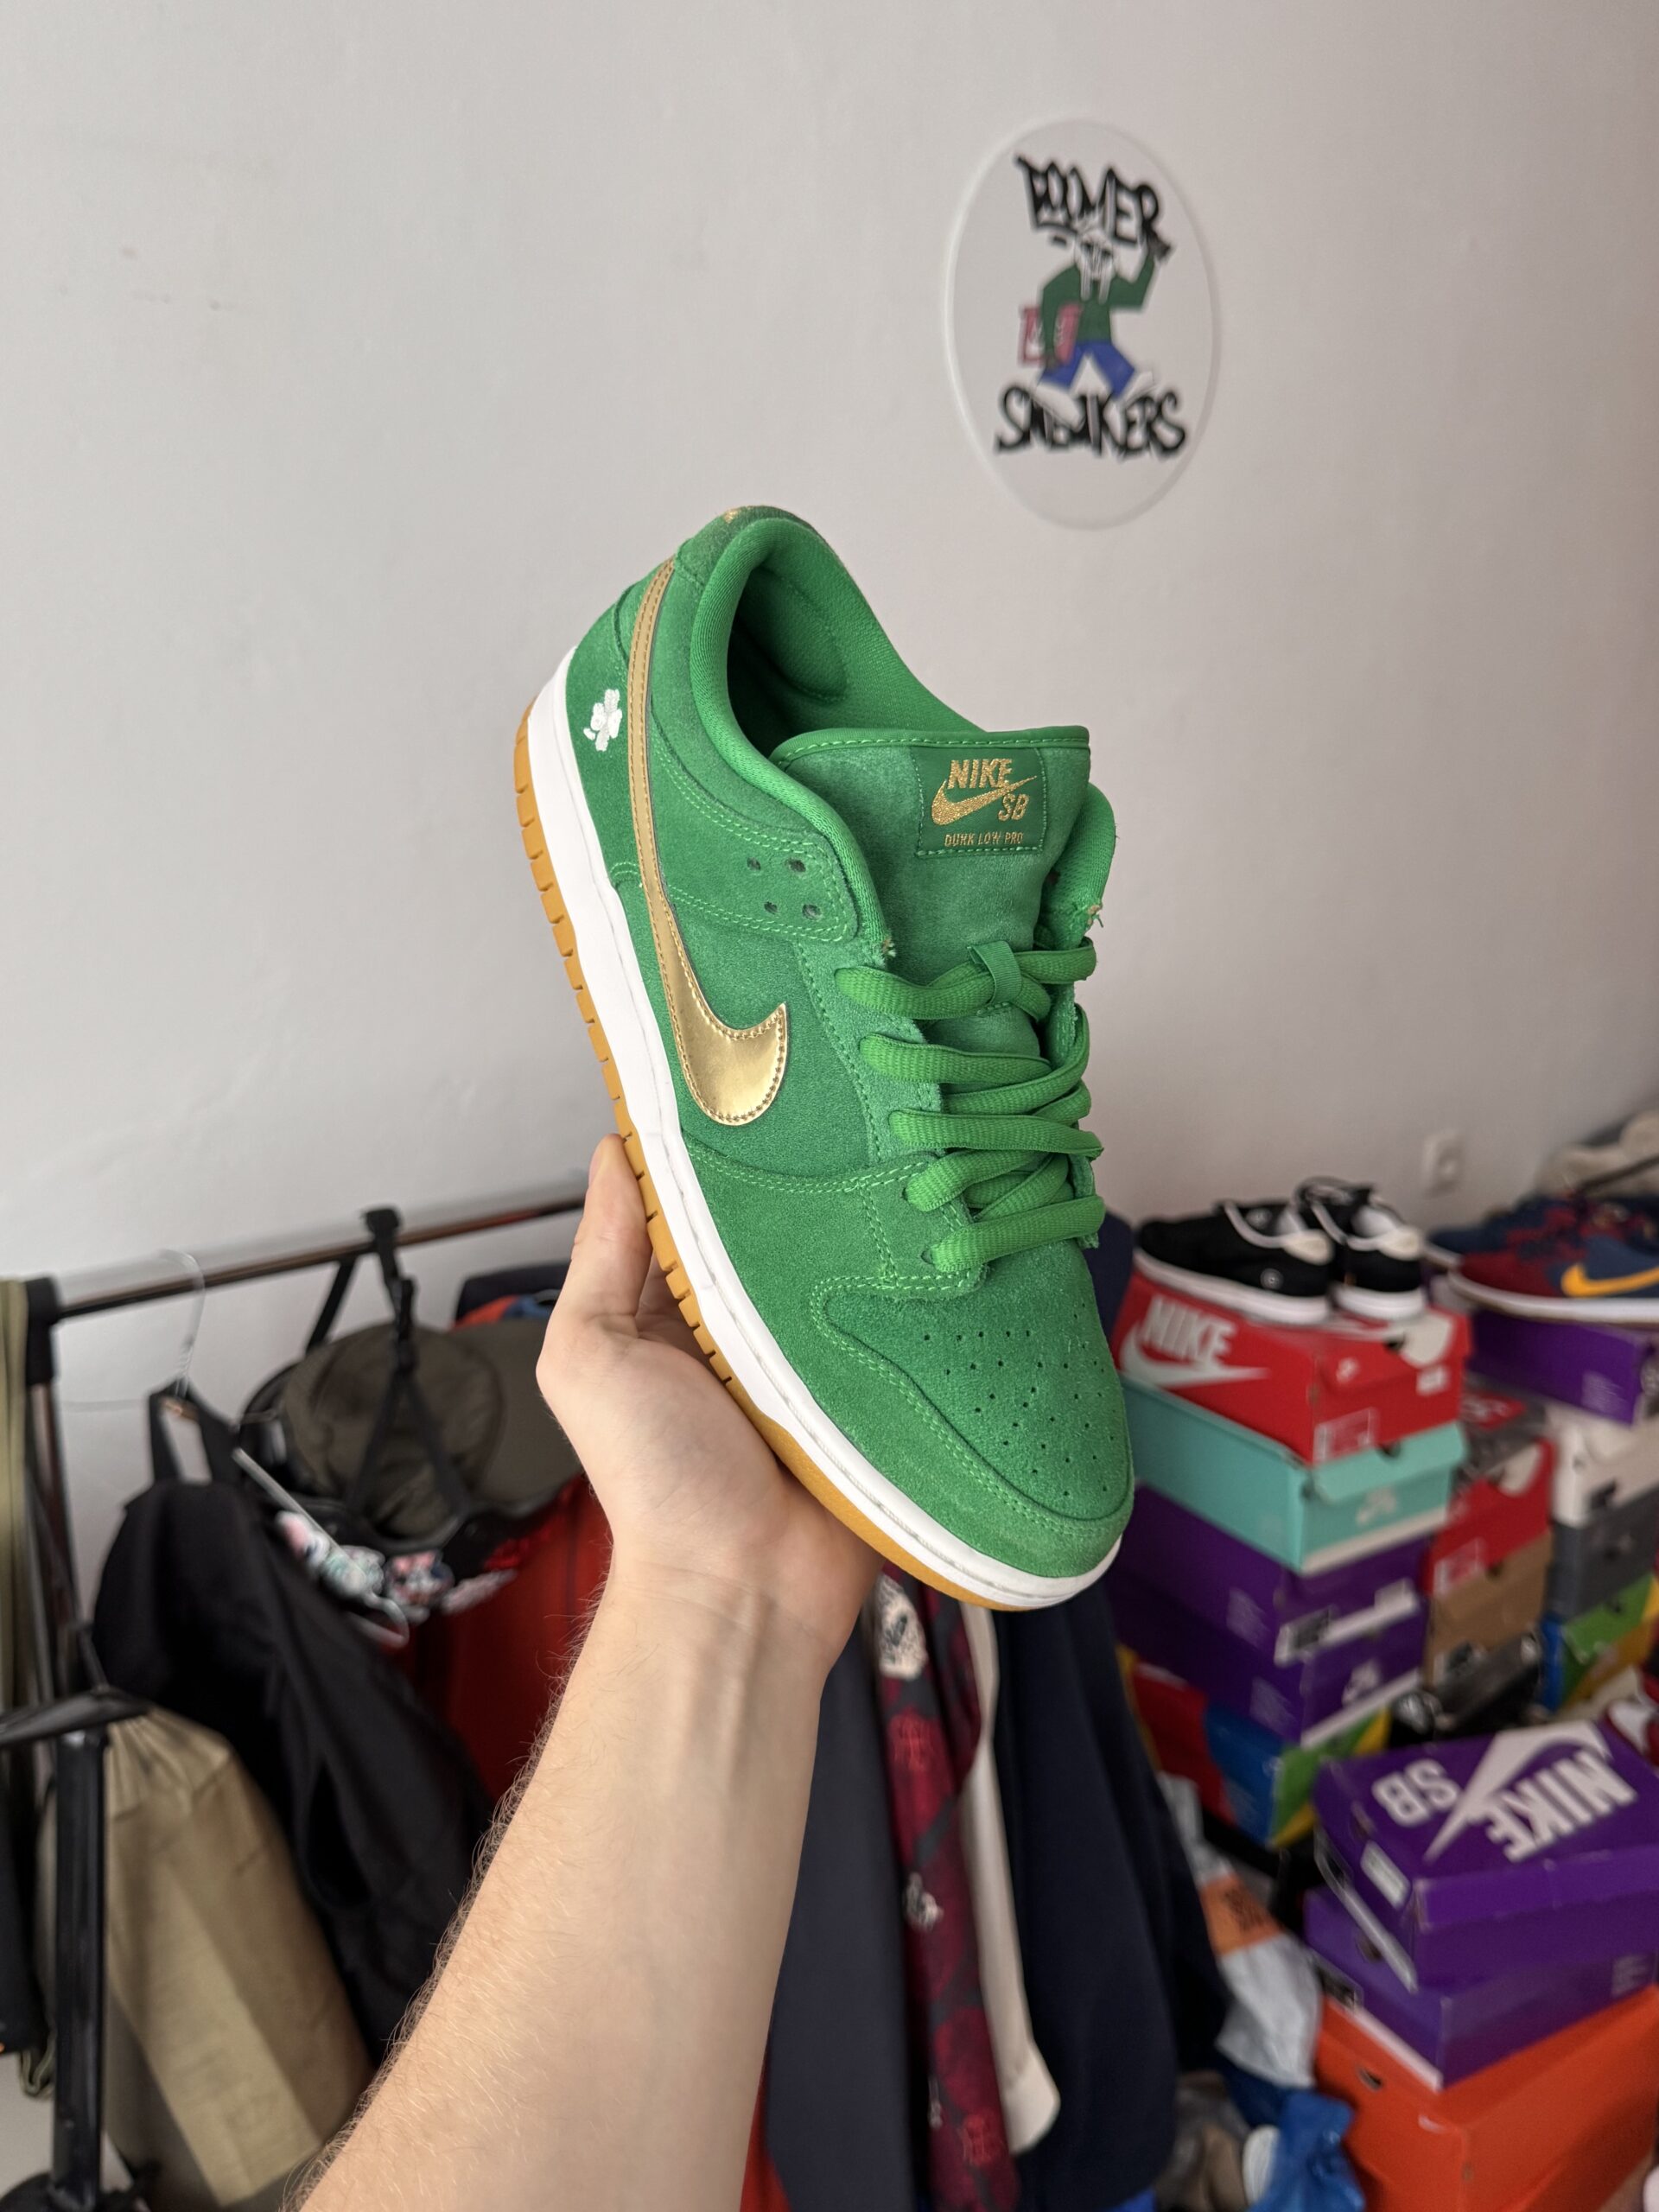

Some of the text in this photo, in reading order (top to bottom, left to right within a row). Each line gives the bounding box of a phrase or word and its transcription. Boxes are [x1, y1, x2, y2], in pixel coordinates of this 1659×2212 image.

[947, 758, 1013, 789] NIKE
[997, 792, 1030, 822] SB
[977, 831, 1001, 846] LOW
[1004, 830, 1024, 845] PRO
[1140, 1293, 1239, 1368] NIKE
[1370, 1758, 1461, 1829] SB
[1466, 1748, 1638, 1864] NIKE
